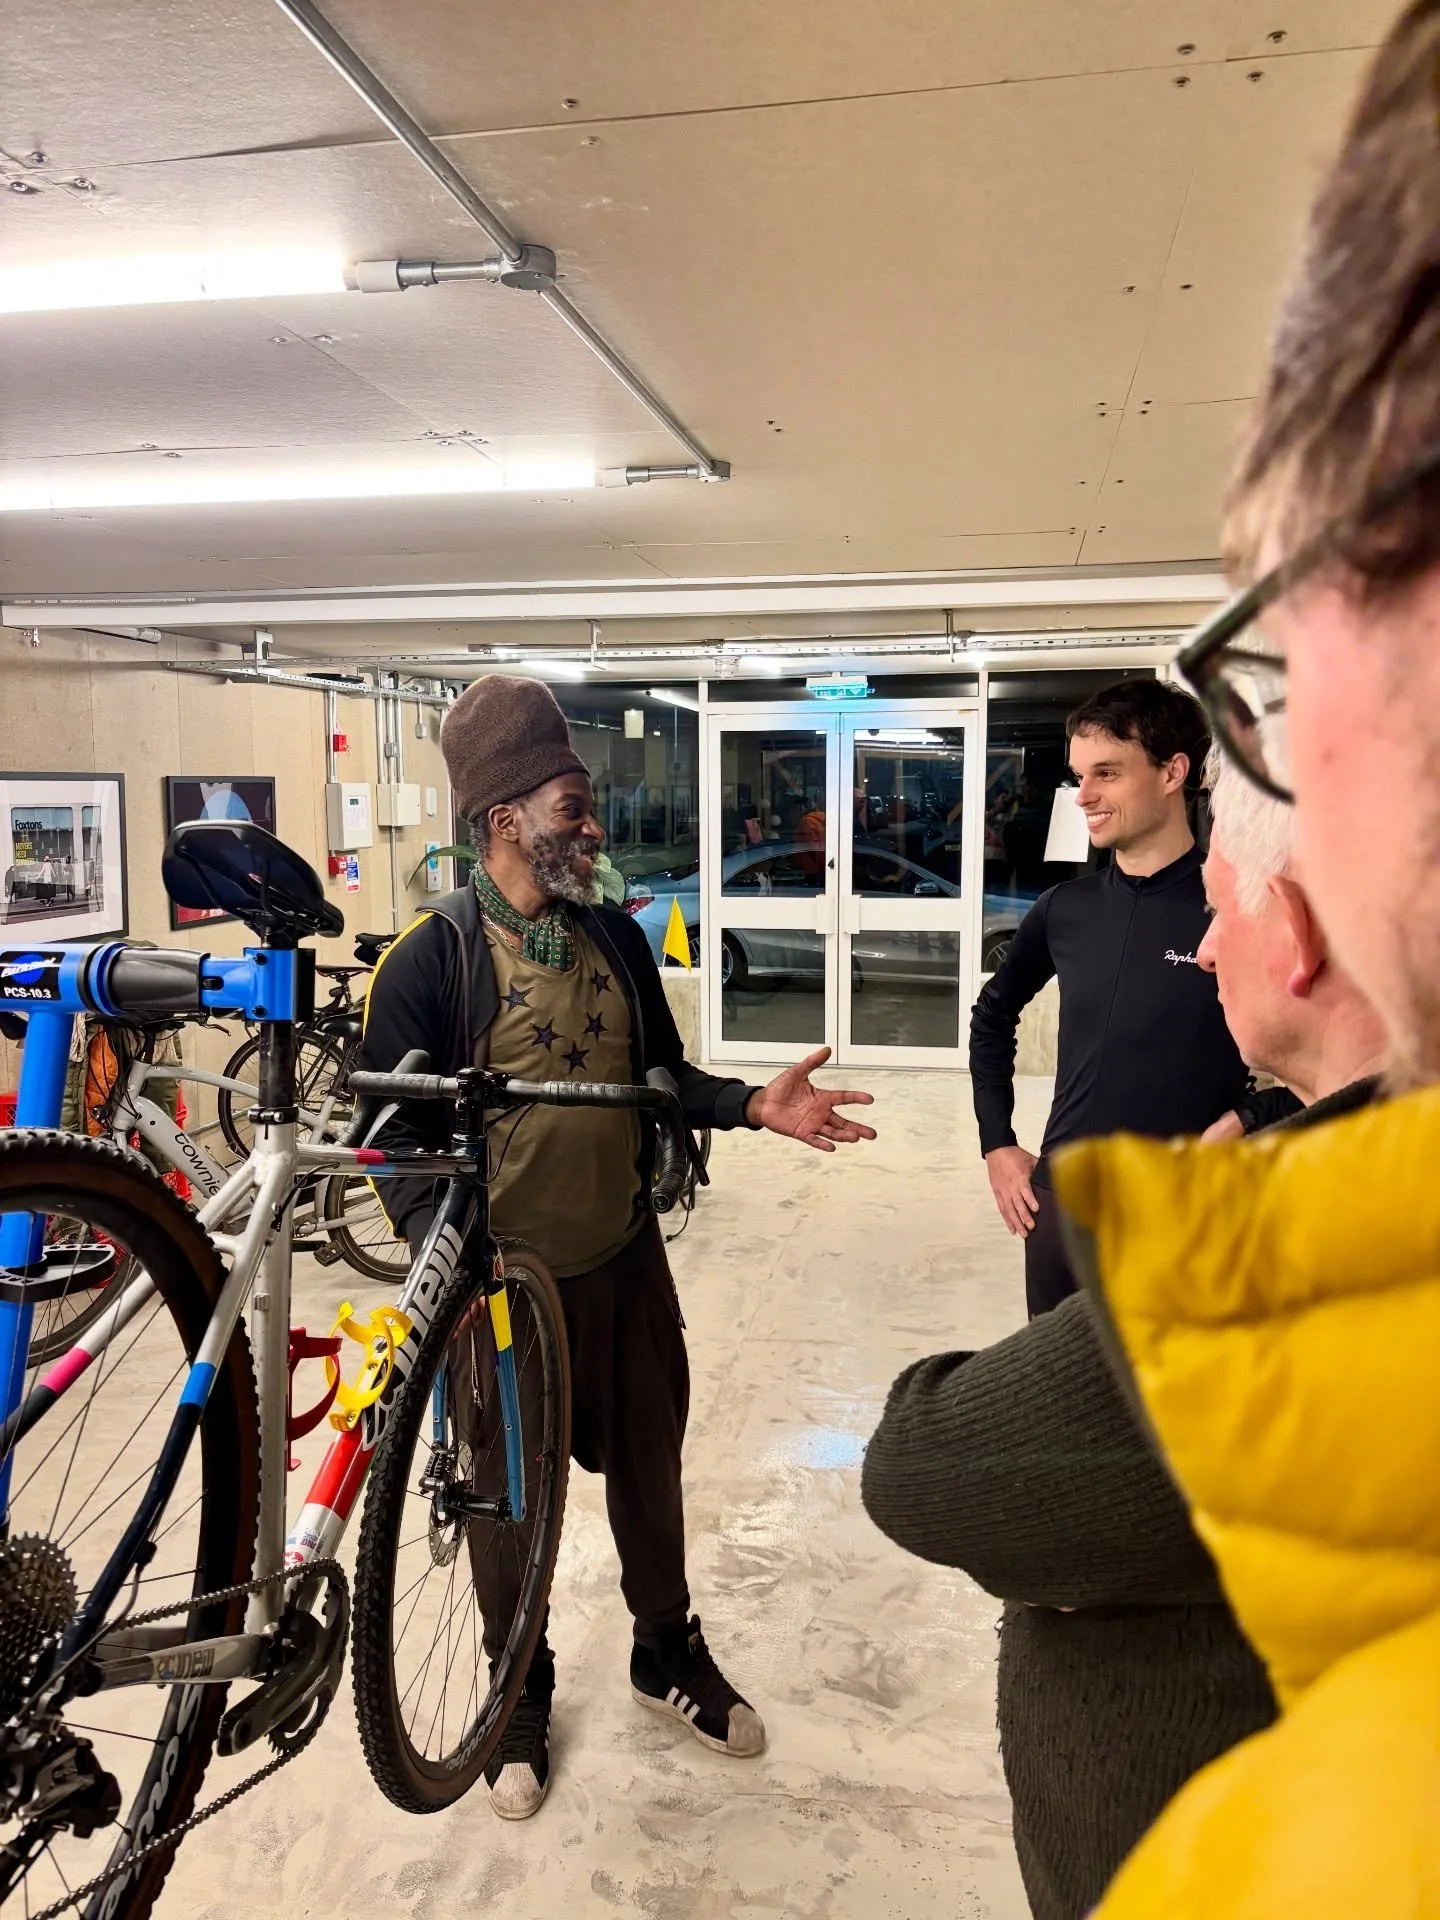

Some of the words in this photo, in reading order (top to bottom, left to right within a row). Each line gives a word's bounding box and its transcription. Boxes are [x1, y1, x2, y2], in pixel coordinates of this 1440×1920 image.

[14, 819, 43, 830] Foxtons
[1164, 949, 1198, 966] Rapha
[3, 986, 52, 999] PCS-10.3
[174, 1131, 221, 1196] townie
